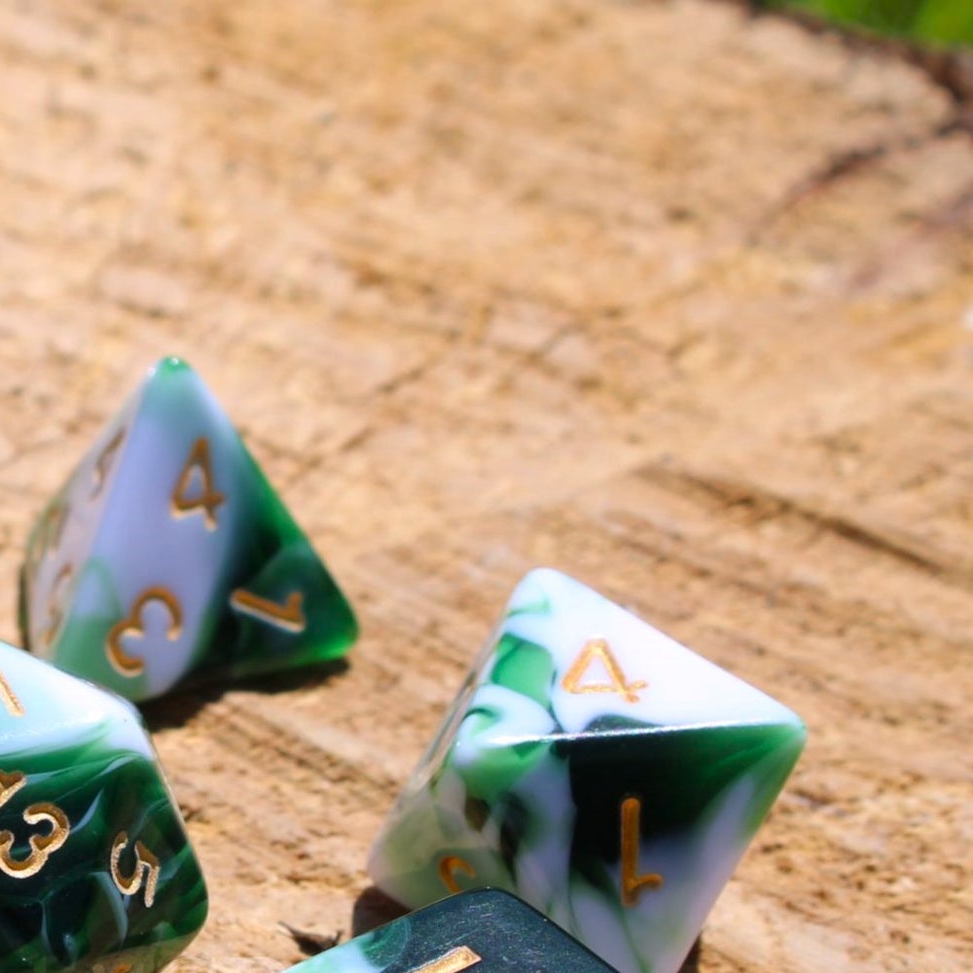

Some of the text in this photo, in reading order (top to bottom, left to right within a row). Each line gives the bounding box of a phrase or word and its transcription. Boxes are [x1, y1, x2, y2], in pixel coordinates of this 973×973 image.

[171, 437, 225, 530] 4
[107, 586, 183, 676] 3
[561, 638, 649, 703] 4
[110, 831, 160, 908] 5
[621, 797, 664, 907] 1
